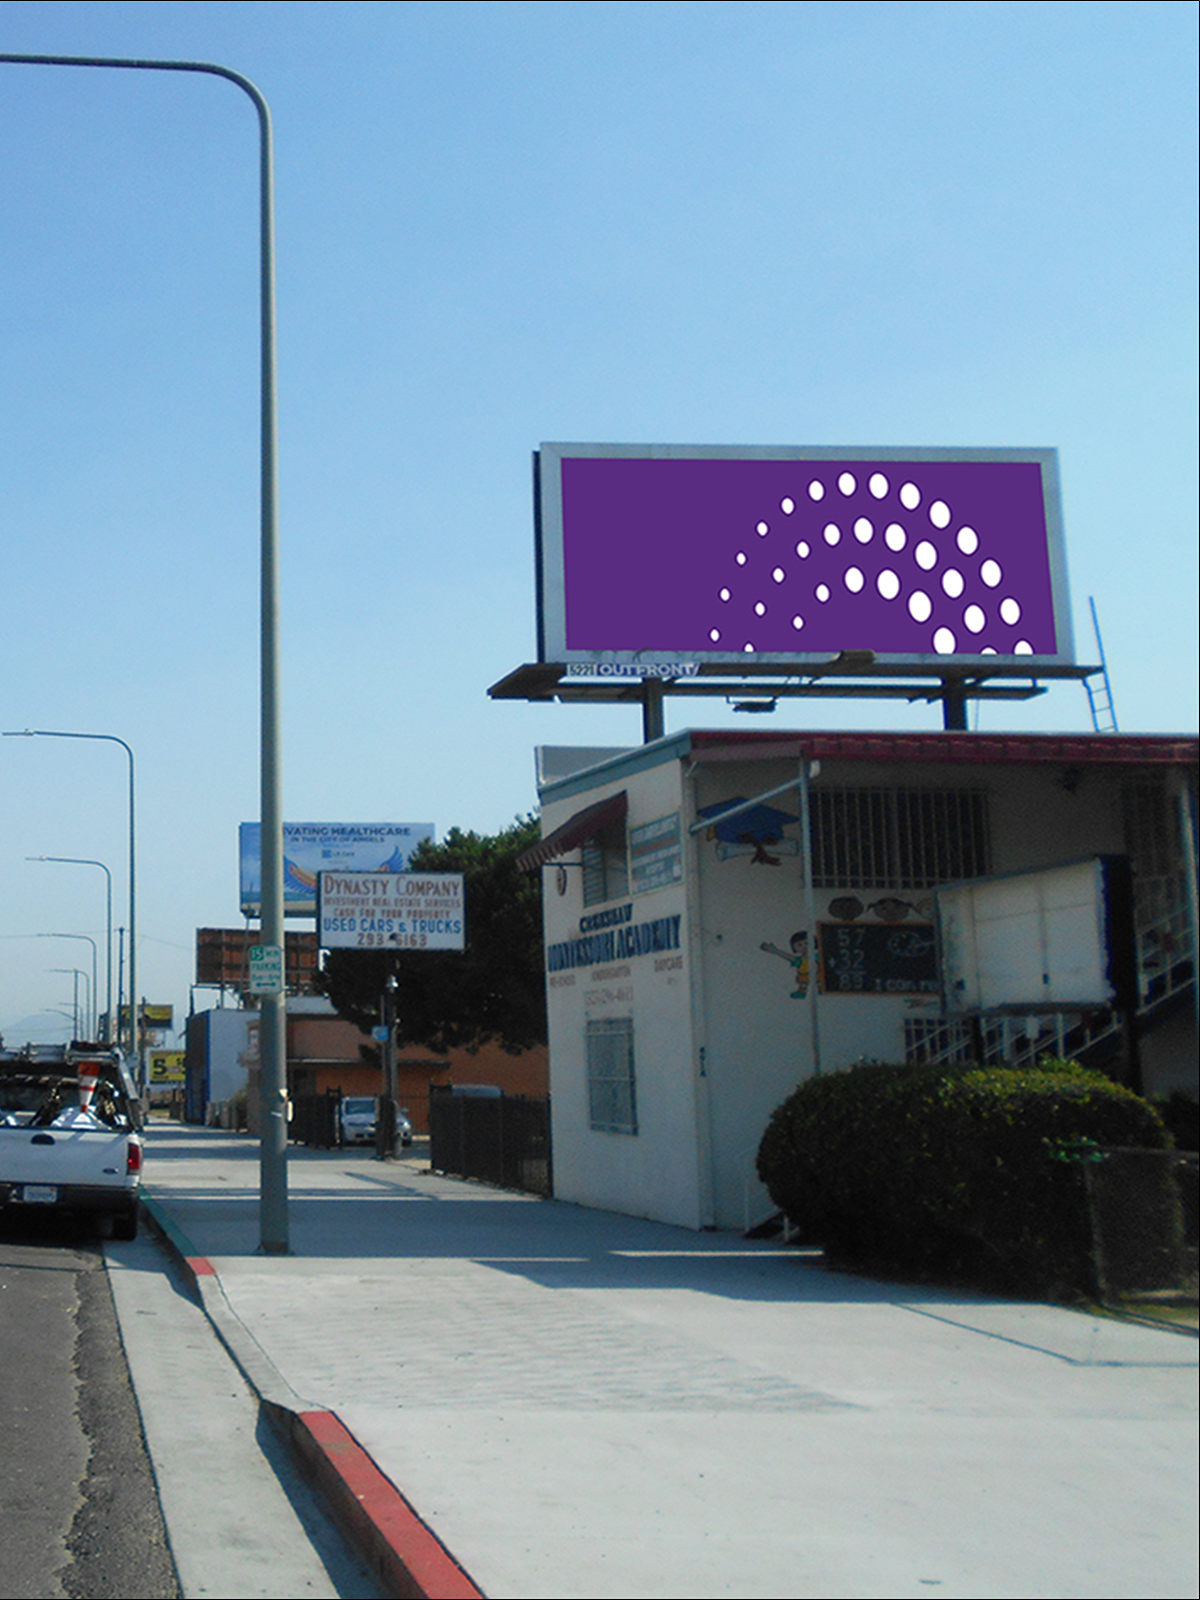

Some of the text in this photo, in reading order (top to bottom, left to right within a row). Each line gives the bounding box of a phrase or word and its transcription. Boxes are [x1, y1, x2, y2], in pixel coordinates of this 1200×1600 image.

[599, 663, 694, 677] OUTFRONT
[283, 826, 411, 837] VATING HEALTHCARE
[323, 875, 461, 897] DYNASTY COMPANY
[323, 897, 461, 909] INVESTMENT REAL ESTATE SERVICES
[334, 908, 452, 919] CASH FOR YOUR PROPERTY
[323, 918, 462, 934] USED CARS & TRUCKS
[838, 926, 867, 947] 57
[839, 974, 865, 992] 89
